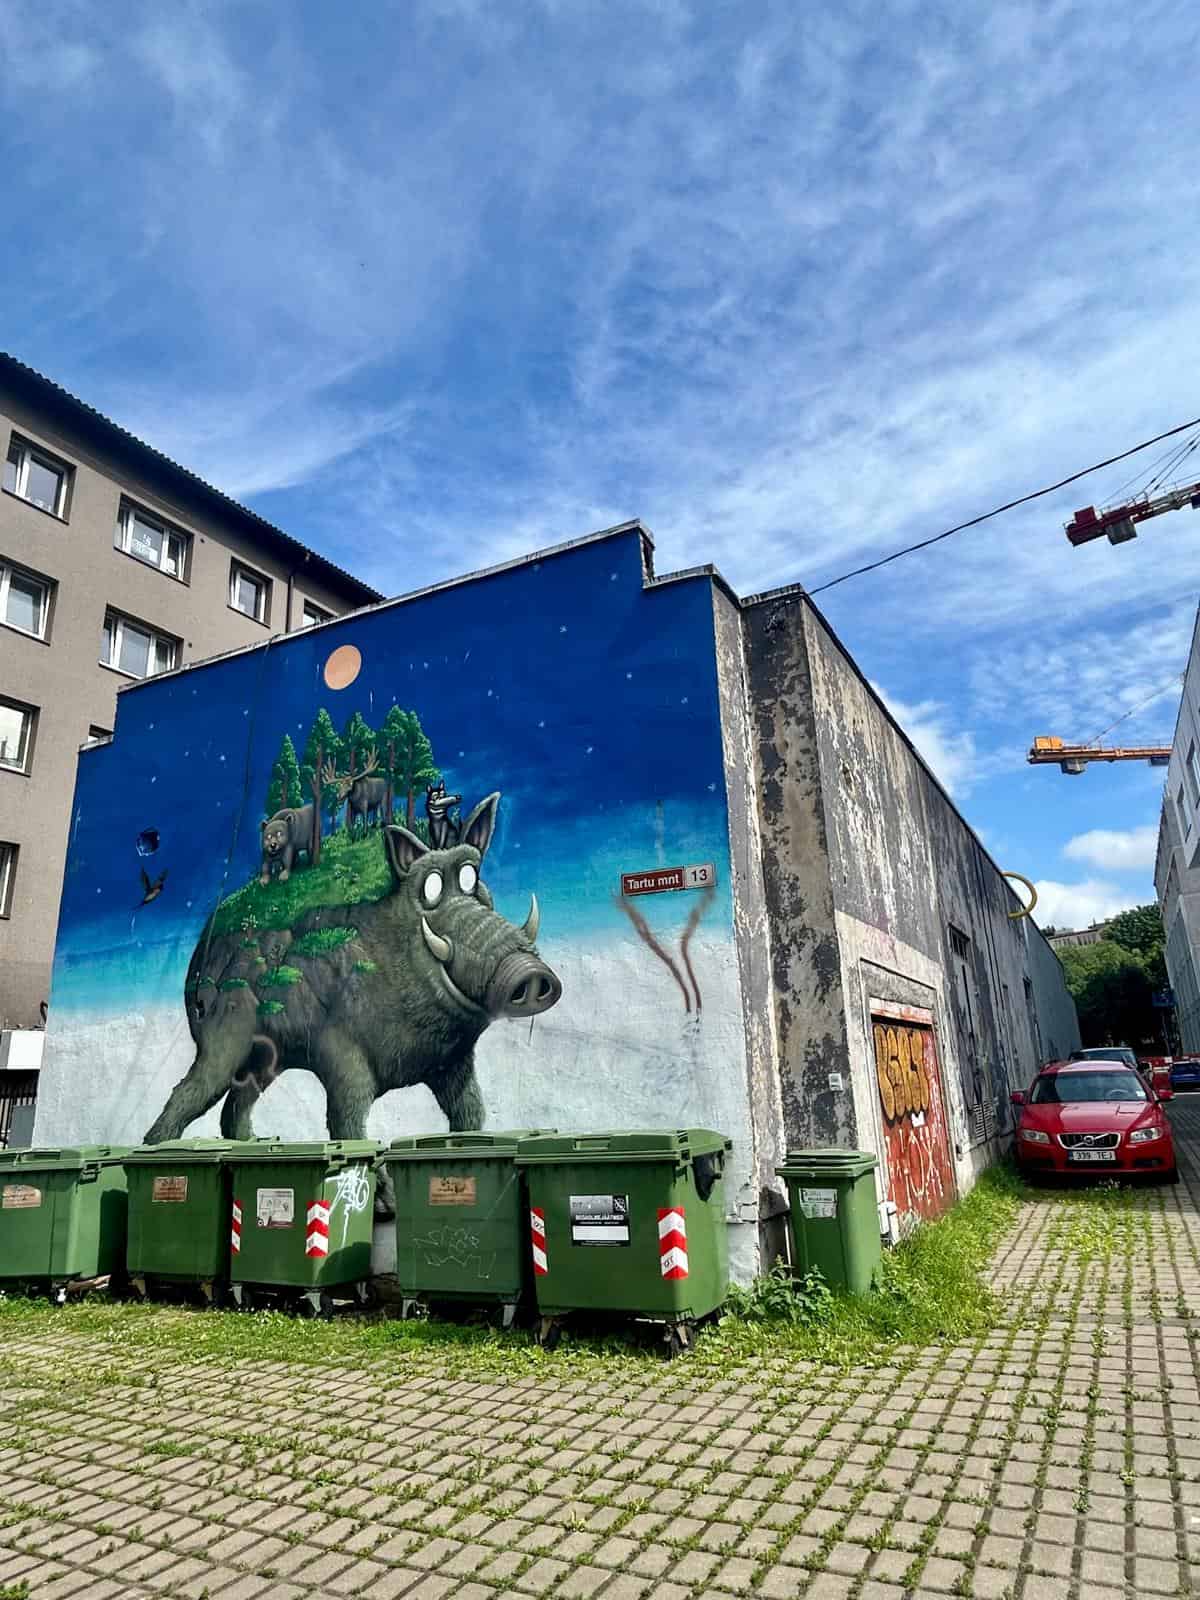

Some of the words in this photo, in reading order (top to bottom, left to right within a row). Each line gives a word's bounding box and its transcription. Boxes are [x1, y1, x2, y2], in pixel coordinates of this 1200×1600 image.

[627, 878, 655, 890] Tartu
[657, 874, 680, 886] mnt
[691, 868, 707, 882] 13
